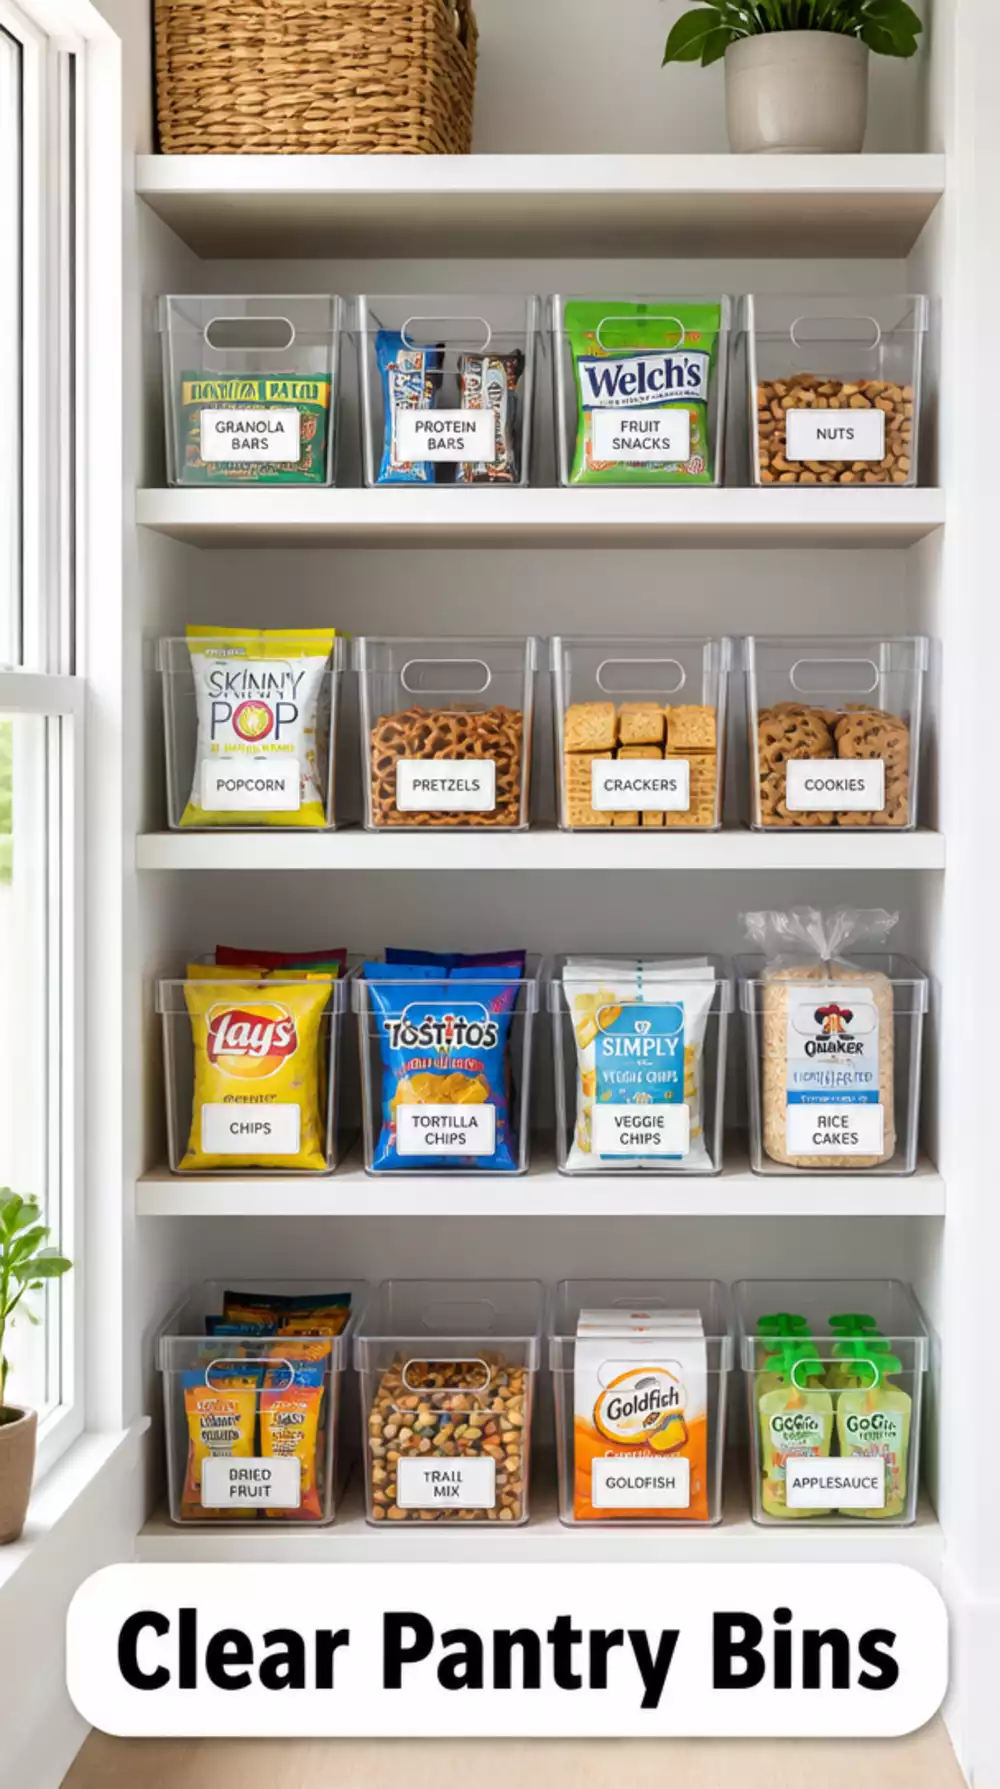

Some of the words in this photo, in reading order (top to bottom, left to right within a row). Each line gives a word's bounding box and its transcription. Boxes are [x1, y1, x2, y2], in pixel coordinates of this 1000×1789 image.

[584, 357, 702, 399] Welch's
[215, 420, 285, 434] GRANOLA
[415, 420, 476, 433] PROTEIN
[620, 420, 661, 433] FRUIT
[816, 427, 855, 440] NUTS
[231, 437, 269, 450] BARS
[427, 437, 465, 450] BARS
[612, 437, 671, 450] SNACKS
[208, 668, 305, 700] SKINNY
[210, 699, 299, 742] POP
[216, 778, 285, 792] POPCORN
[412, 778, 481, 792] PRETZELS
[603, 779, 677, 792] CRACKERS
[804, 778, 865, 792] COOKIES
[602, 1036, 679, 1057] SIMPLY
[229, 1122, 272, 1135] CHIPS
[411, 1115, 479, 1129] TORTILLA
[614, 1115, 665, 1129] VEGGIE
[817, 1115, 849, 1129] RICE
[424, 1132, 467, 1145] CHIPS
[619, 1132, 661, 1146] CHIPS
[812, 1132, 859, 1145] CAKES
[229, 1468, 272, 1482] DRIED
[424, 1470, 463, 1483] TRAIL
[605, 1476, 676, 1489] GOLDFISH
[792, 1476, 878, 1489] APPLESAUCE
[229, 1484, 272, 1498] FRUIT
[433, 1485, 460, 1498] MIX
